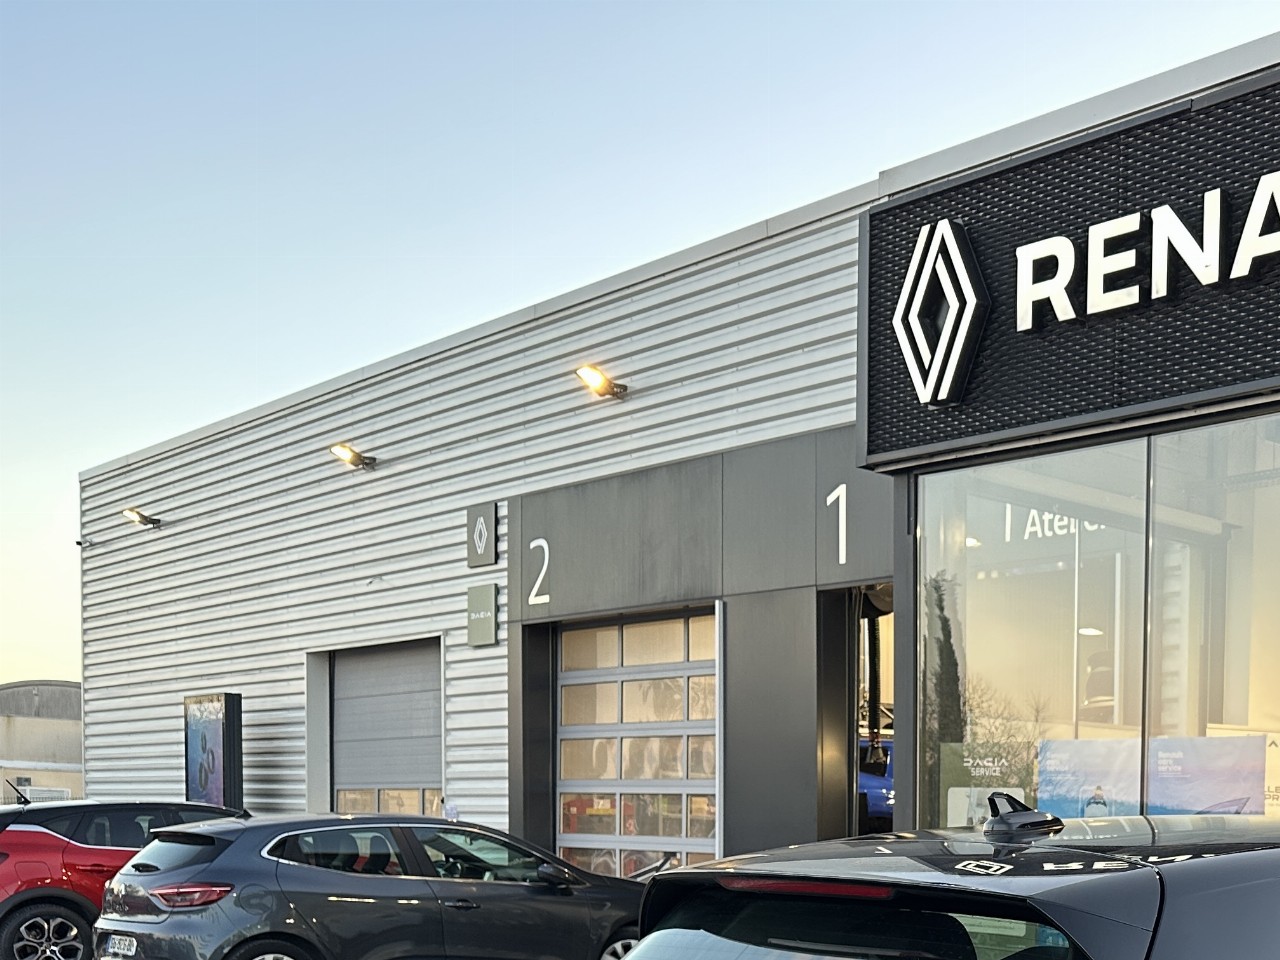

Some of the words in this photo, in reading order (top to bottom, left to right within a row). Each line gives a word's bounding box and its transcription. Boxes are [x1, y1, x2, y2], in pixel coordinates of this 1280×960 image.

[826, 483, 847, 565] 1
[528, 537, 550, 606] 2
[470, 611, 492, 620] DACIA
[963, 758, 1009, 767] DACIA
[971, 767, 1001, 777] SERVICE
